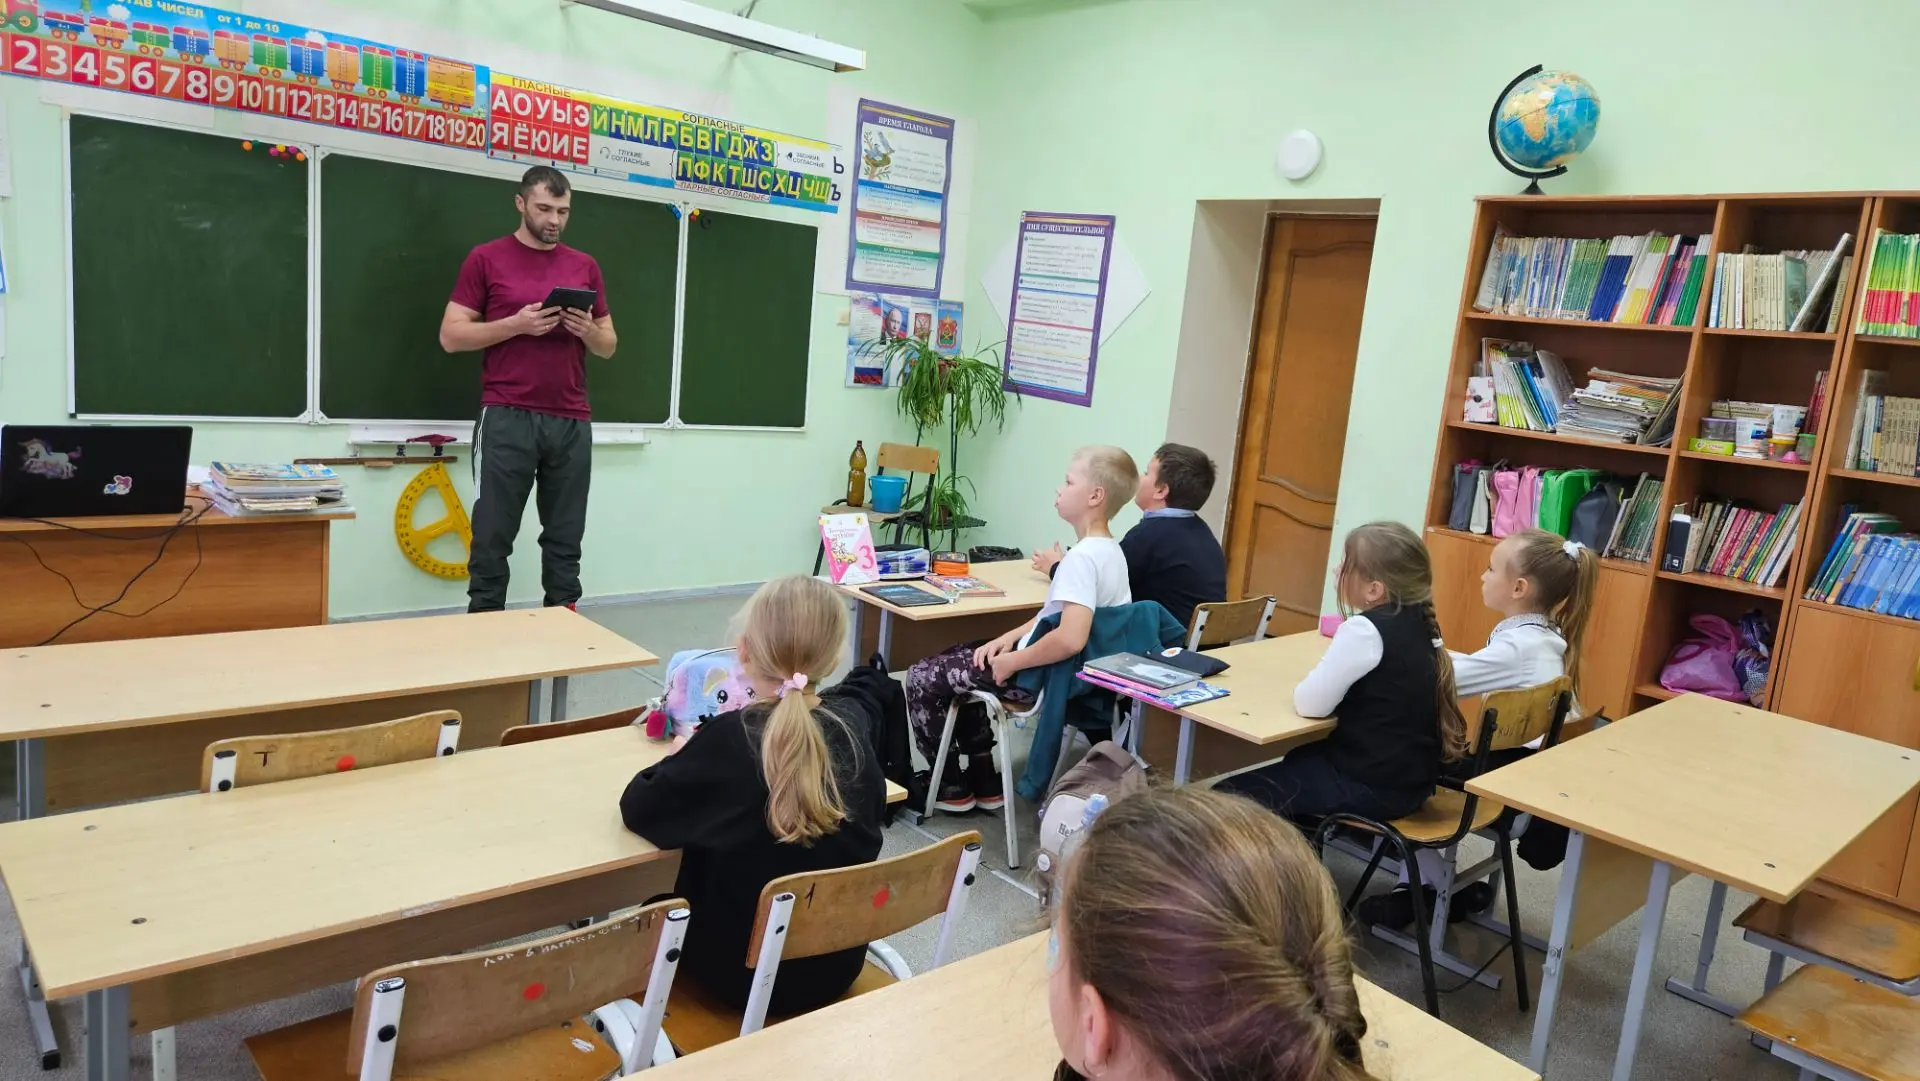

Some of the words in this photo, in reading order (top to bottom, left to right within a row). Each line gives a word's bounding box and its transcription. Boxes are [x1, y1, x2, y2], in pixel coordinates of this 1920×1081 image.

[157, 1, 204, 18] ЧИСЕЛ
[14, 40, 38, 72] 2
[45, 45, 68, 75] 3
[74, 52, 98, 81] 4
[104, 56, 126, 85] 5
[131, 61, 154, 90] 6
[160, 66, 181, 94] 7
[186, 70, 208, 98] 8
[214, 75, 235, 102] 9
[238, 80, 262, 108] 10
[265, 84, 286, 113] 11
[289, 89, 311, 117] 12
[314, 94, 335, 121] 13
[337, 98, 359, 125] 14
[361, 101, 381, 128] 15
[383, 105, 403, 132] 16
[405, 110, 425, 135] 17
[427, 114, 446, 140] 18
[447, 118, 466, 142] 19
[467, 122, 486, 147] 20
[512, 78, 571, 97] ГЛАСНЫЕ
[682, 113, 745, 133] СОГЛАСНЫЕ
[878, 116, 902, 128] ВРЕМЯ
[680, 182, 715, 194] ПАРНЫЕ
[717, 188, 766, 200] СОГЛАСНЫЕ
[859, 545, 874, 569] 3
